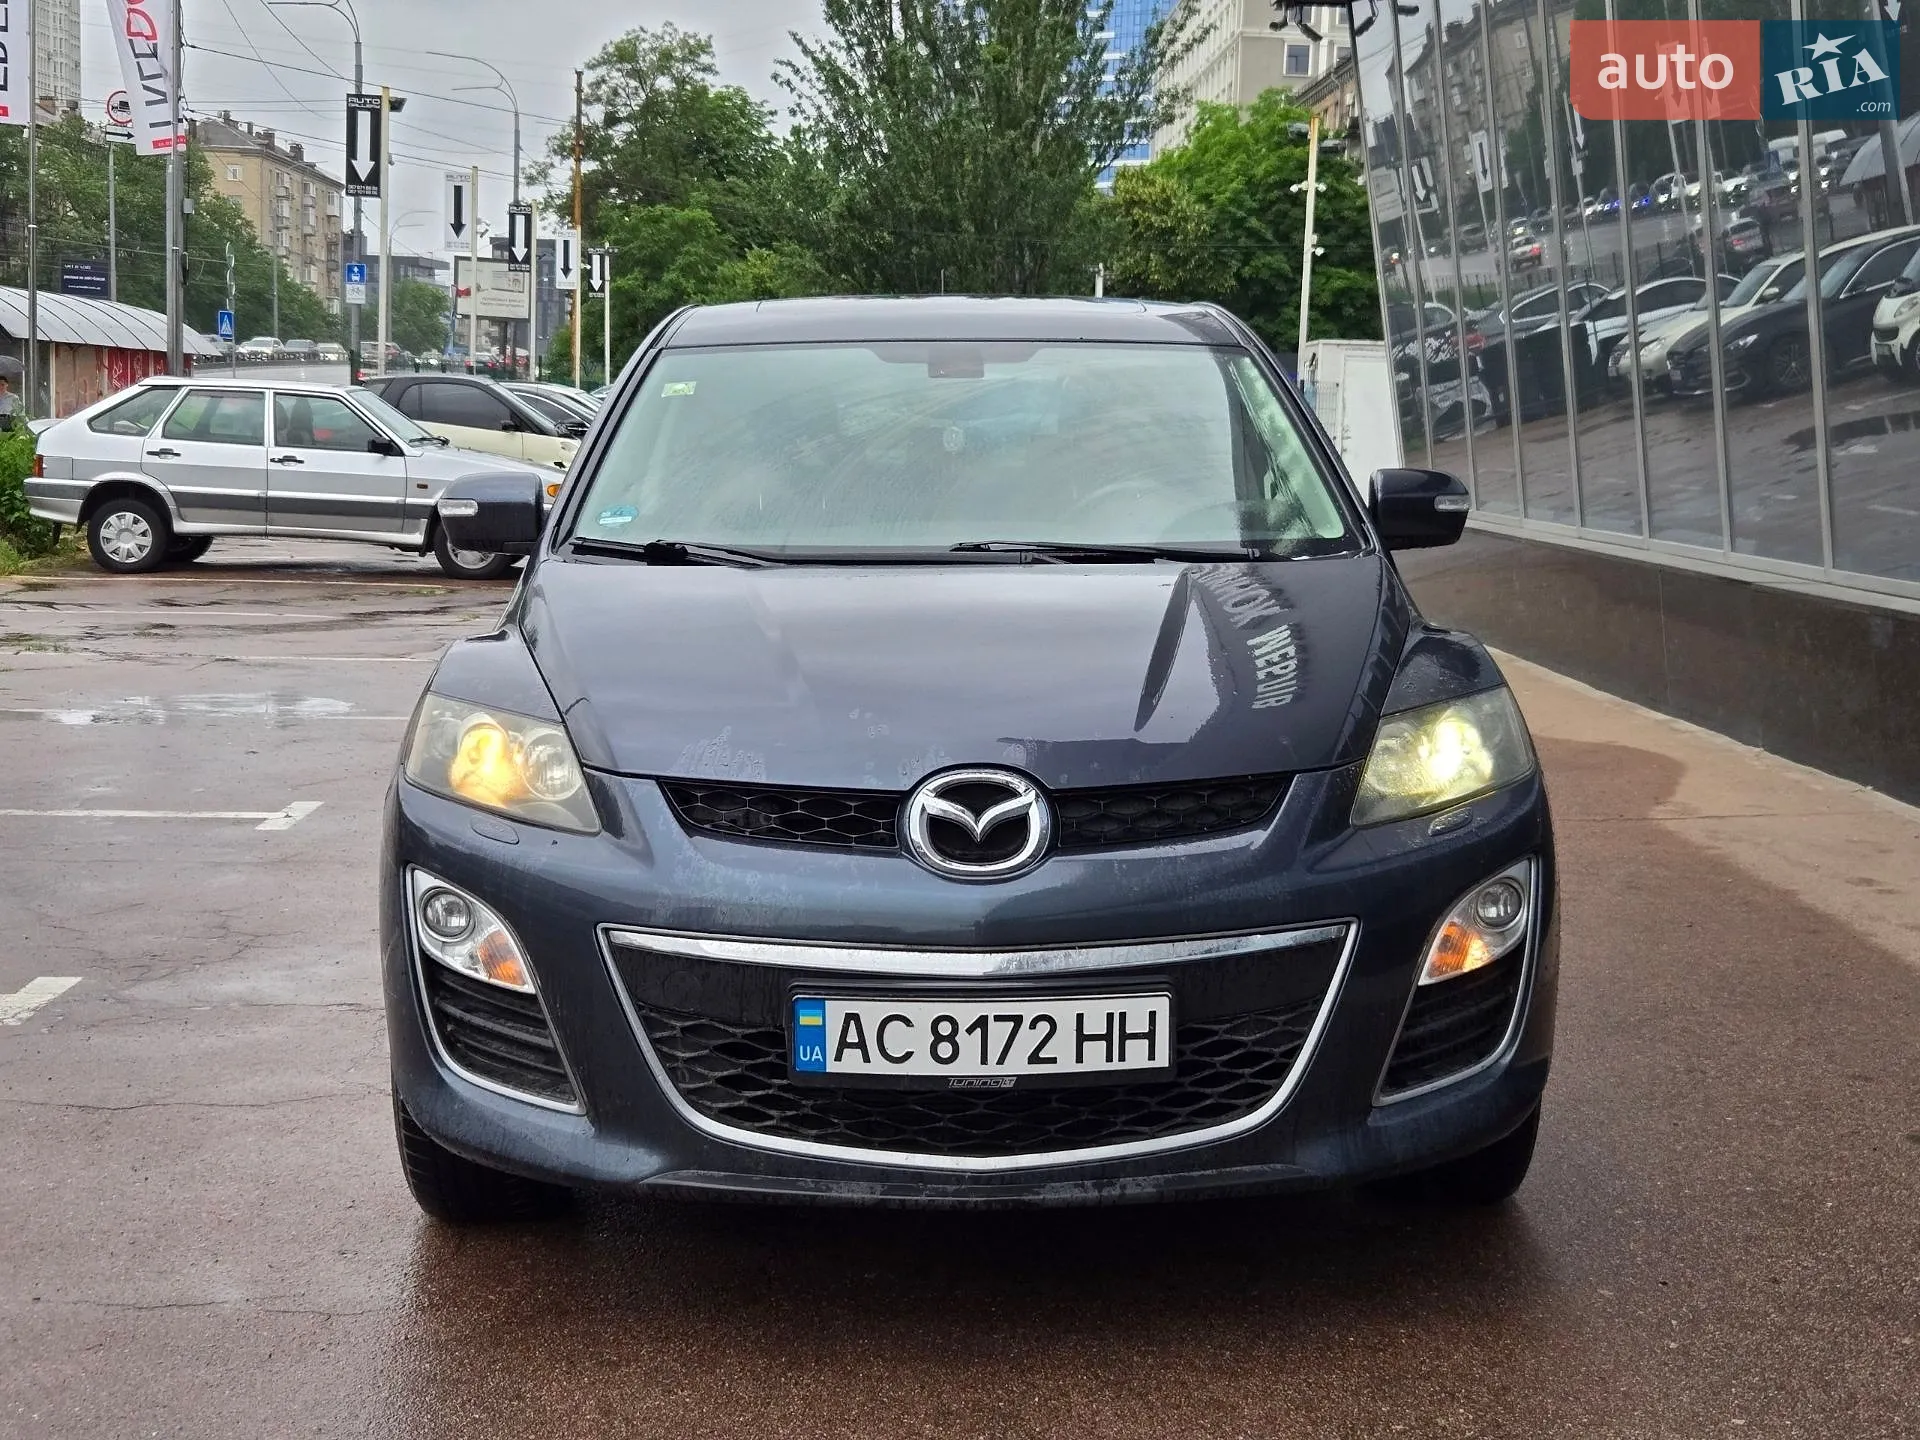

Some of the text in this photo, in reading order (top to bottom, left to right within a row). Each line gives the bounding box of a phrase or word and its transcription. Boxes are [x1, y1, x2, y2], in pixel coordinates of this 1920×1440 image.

[799, 1045, 824, 1062] UA
[833, 1010, 1158, 1066] AC 8172 HH
